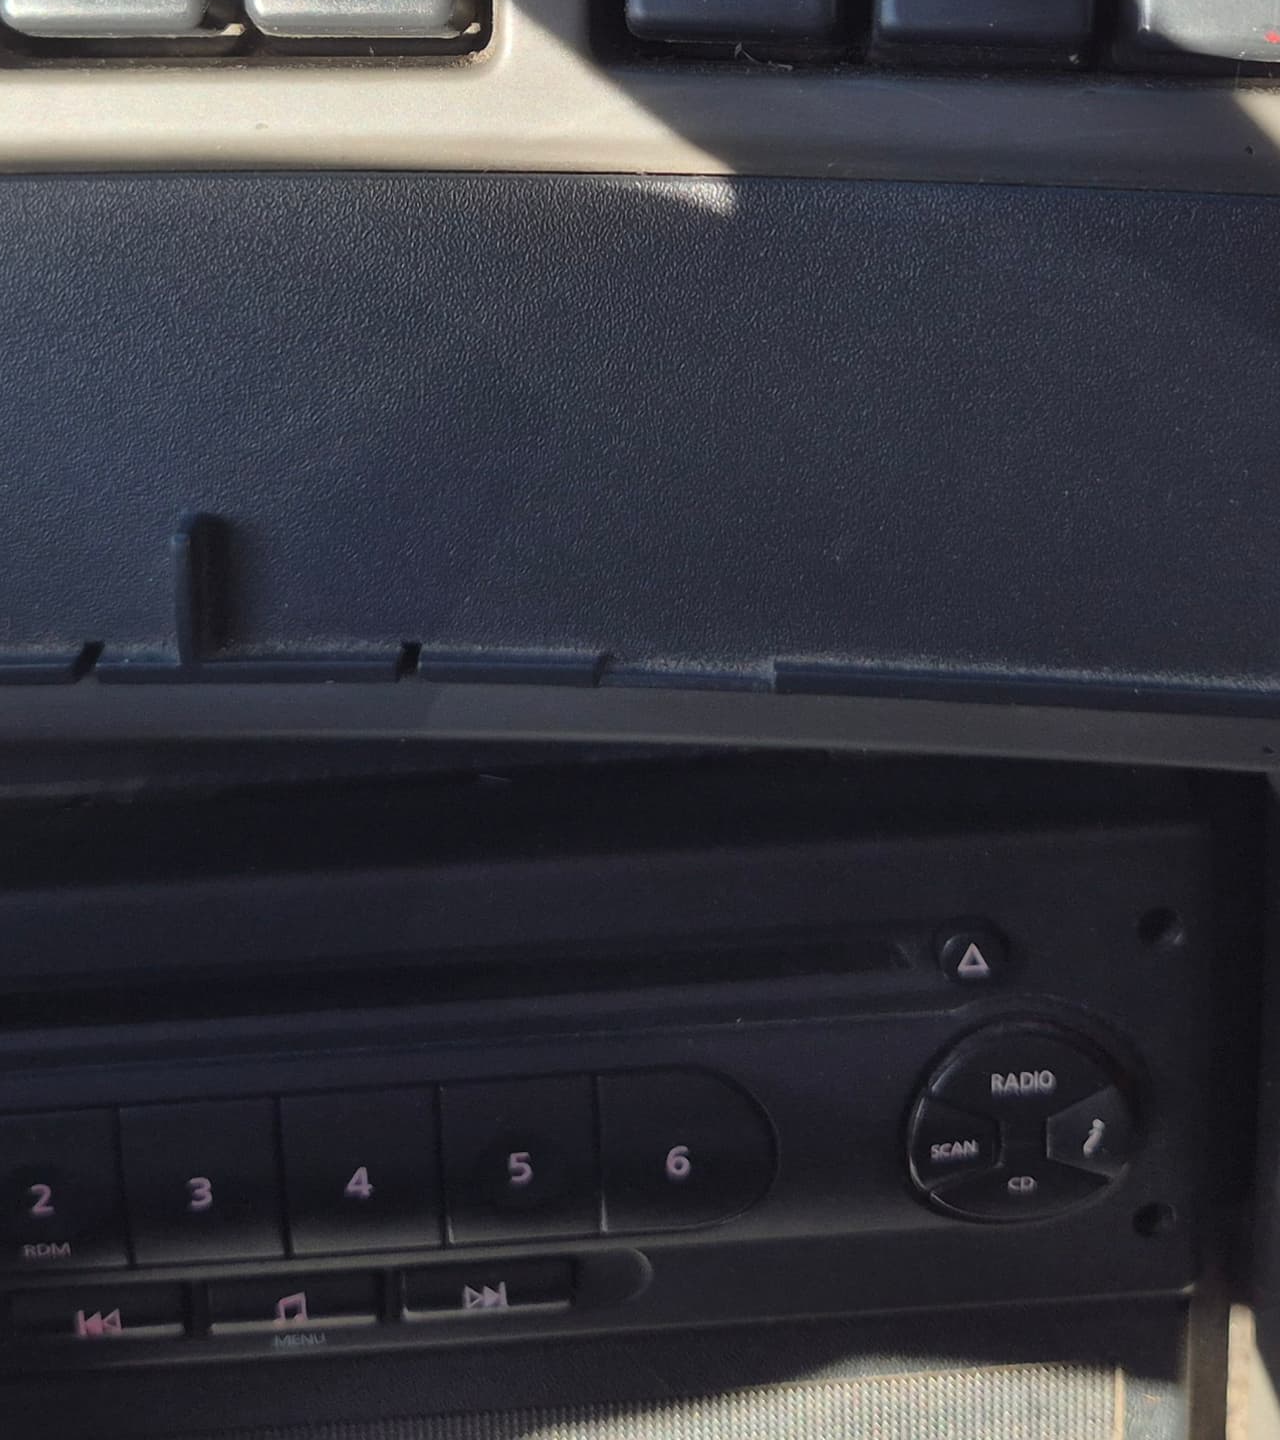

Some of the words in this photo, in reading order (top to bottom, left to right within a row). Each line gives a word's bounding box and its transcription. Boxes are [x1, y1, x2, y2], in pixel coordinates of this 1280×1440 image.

[991, 1069, 1056, 1095] RADIO
[665, 1145, 692, 1178] 6
[930, 1139, 979, 1161] SCAN
[345, 1167, 373, 1199] 4
[507, 1152, 533, 1185] 5
[186, 1177, 213, 1210] 3
[1007, 1176, 1038, 1193] CD
[29, 1184, 55, 1216] 2
[23, 1242, 71, 1257] RDM
[273, 1332, 326, 1347] MENU
